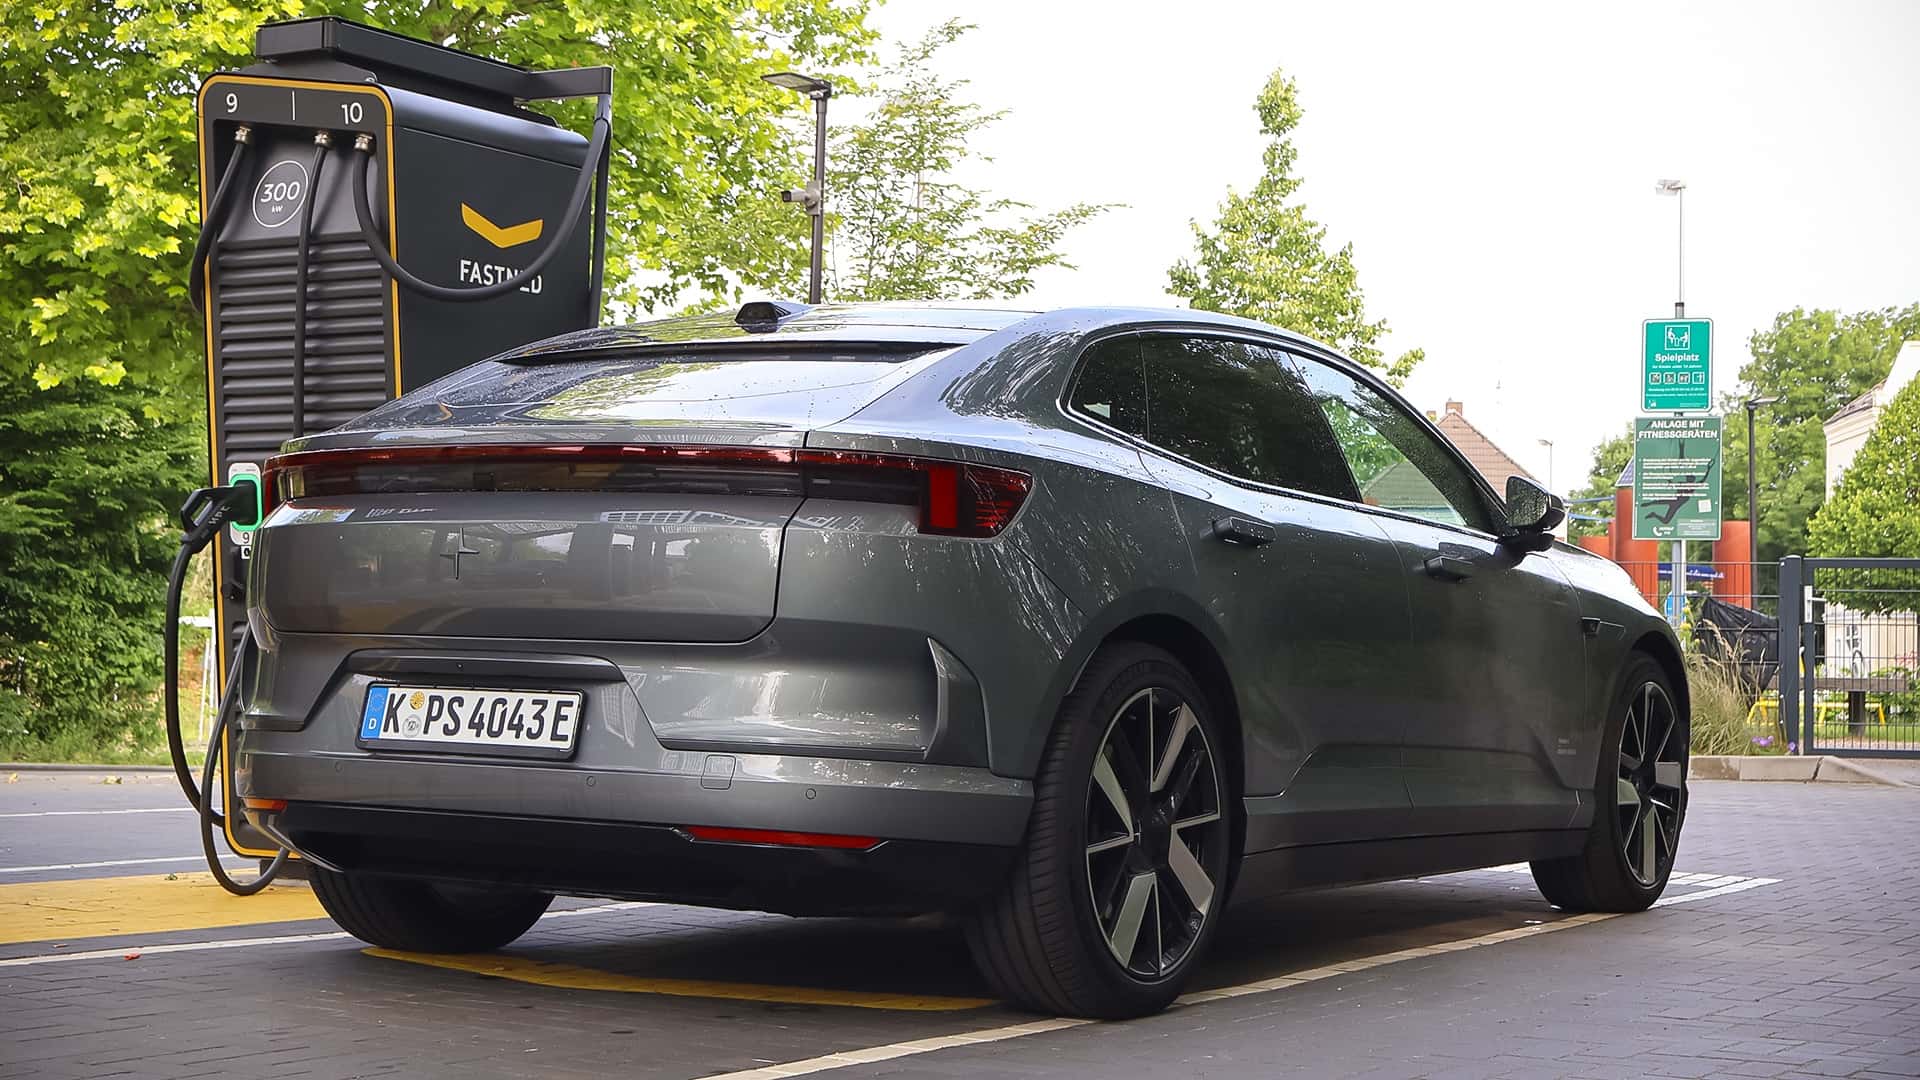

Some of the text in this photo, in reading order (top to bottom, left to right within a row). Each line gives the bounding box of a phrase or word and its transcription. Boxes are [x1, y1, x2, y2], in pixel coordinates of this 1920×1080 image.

[225, 93, 238, 113] 9
[341, 102, 363, 125] 10
[260, 181, 300, 203] 300
[460, 259, 542, 294] FASTND
[1654, 353, 1700, 364] Spielplatz
[1638, 430, 1718, 439] FITNESSGERÄTEN
[1650, 420, 1705, 429] ANLAGE MIT
[382, 692, 407, 733] K
[368, 719, 377, 730] D
